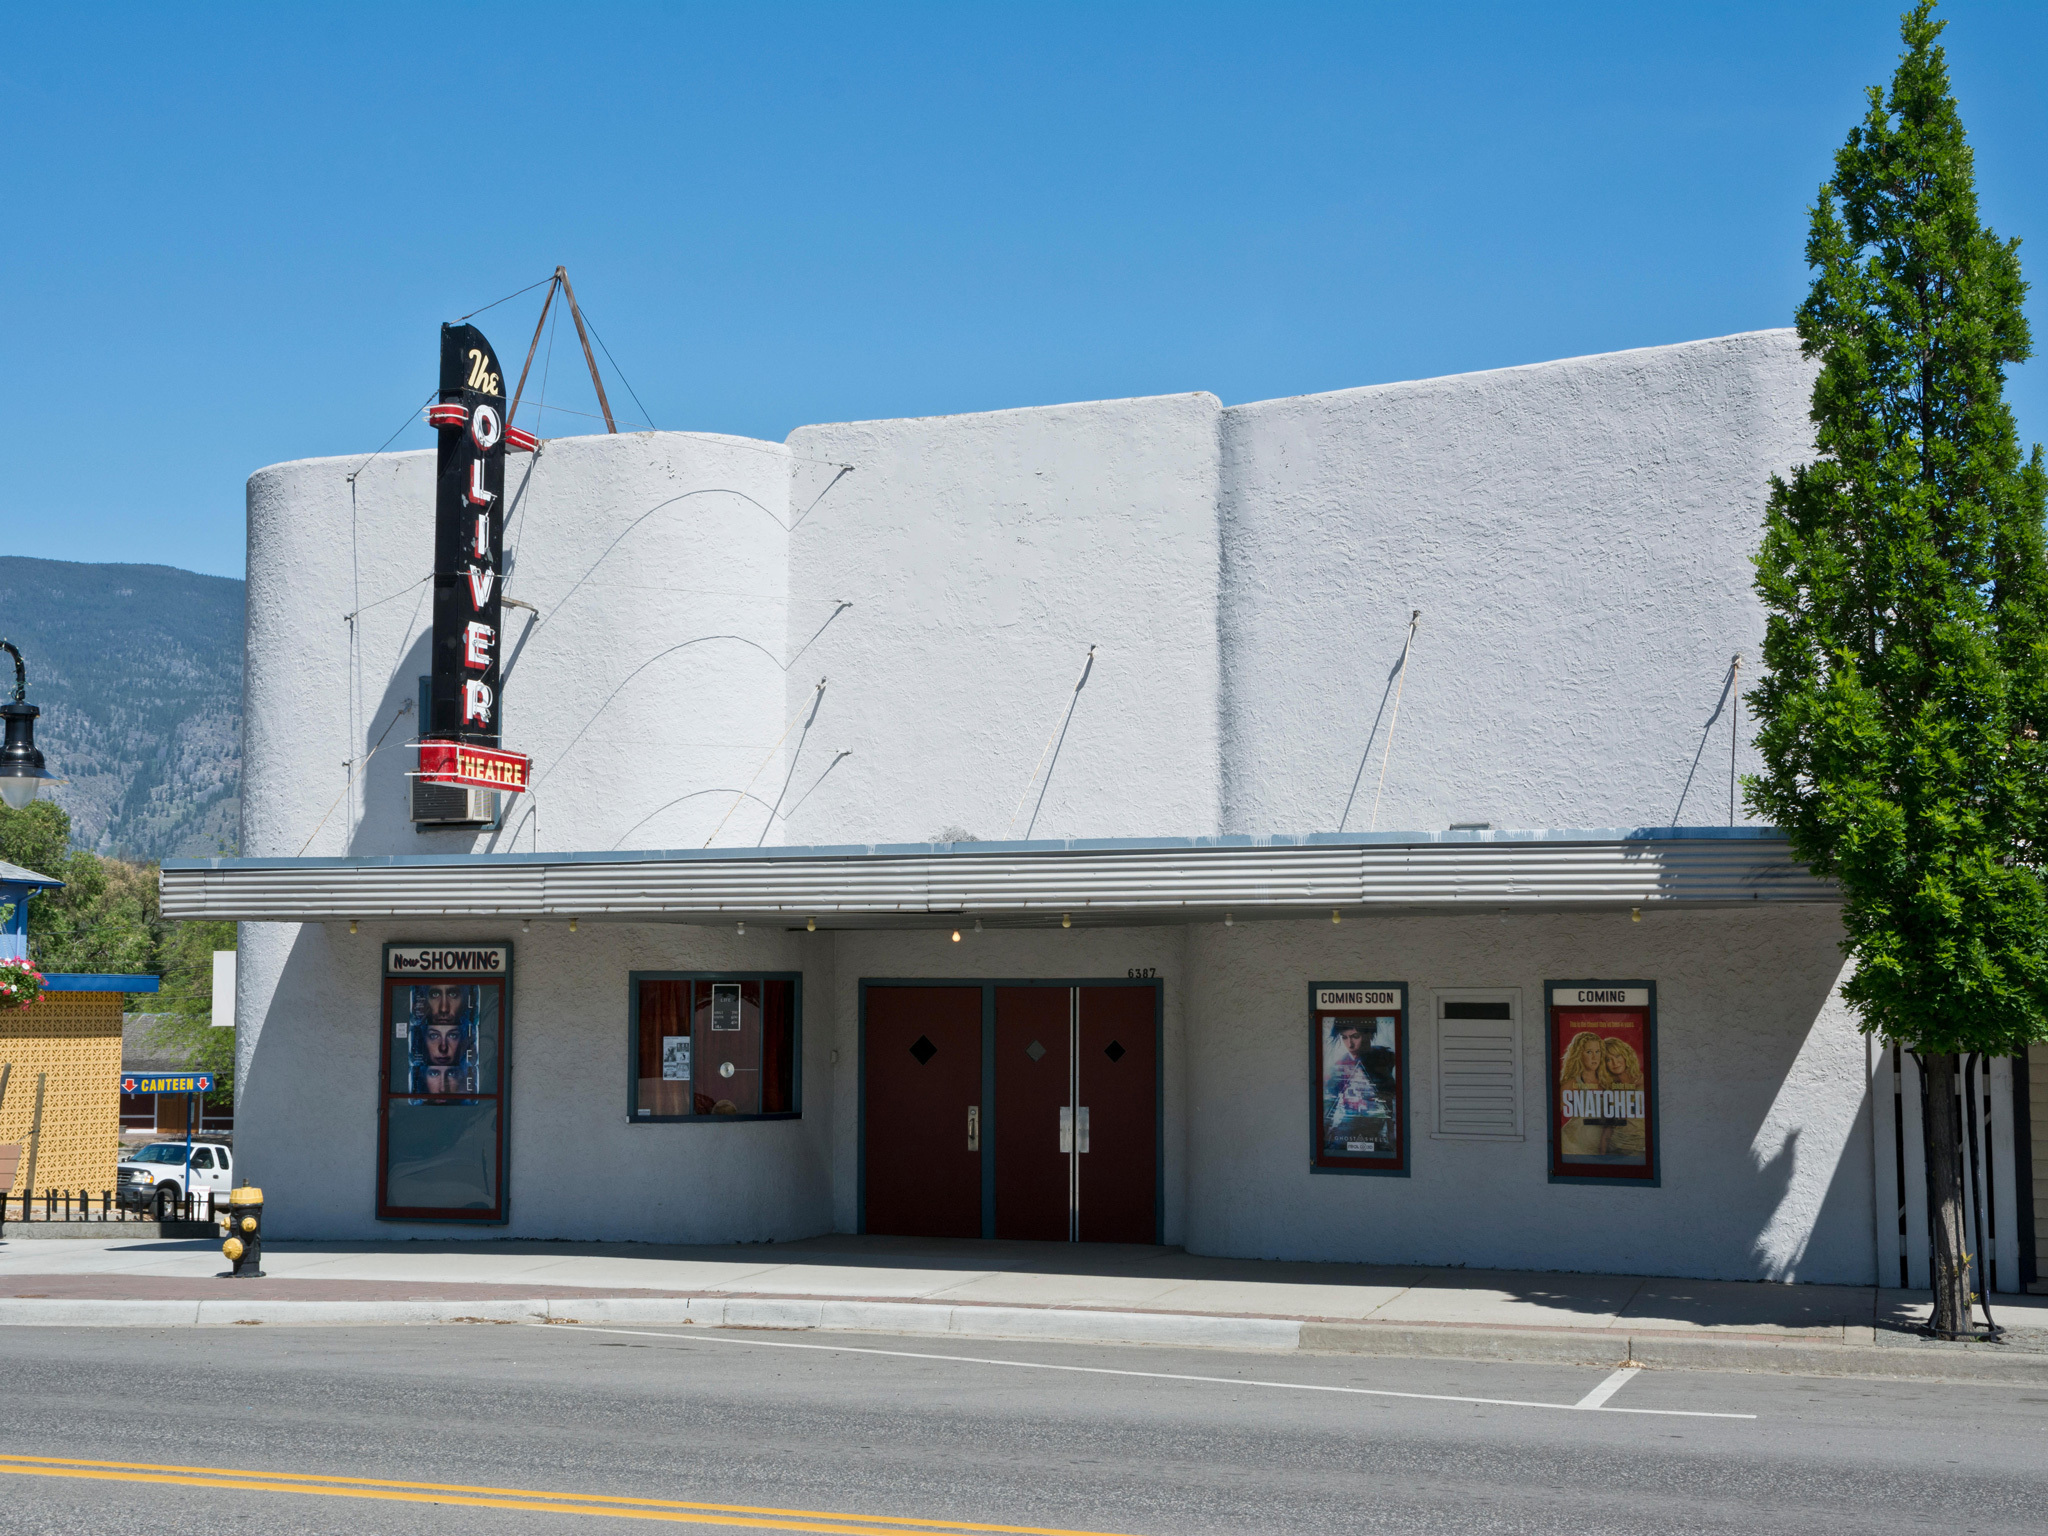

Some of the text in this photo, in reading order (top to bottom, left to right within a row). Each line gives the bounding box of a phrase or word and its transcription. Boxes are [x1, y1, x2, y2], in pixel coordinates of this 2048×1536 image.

[468, 348, 500, 395] The
[462, 404, 502, 728] OLIVER
[457, 753, 524, 787] THEATRE
[394, 950, 500, 971] Now SHOWING
[1128, 967, 1156, 979] 6387
[1321, 992, 1394, 1004] COMING SOON
[1578, 990, 1626, 1003] COMING
[466, 994, 474, 1091] LIFE
[141, 1078, 193, 1092] CANTEEN
[1562, 1089, 1645, 1119] SNATCHED
